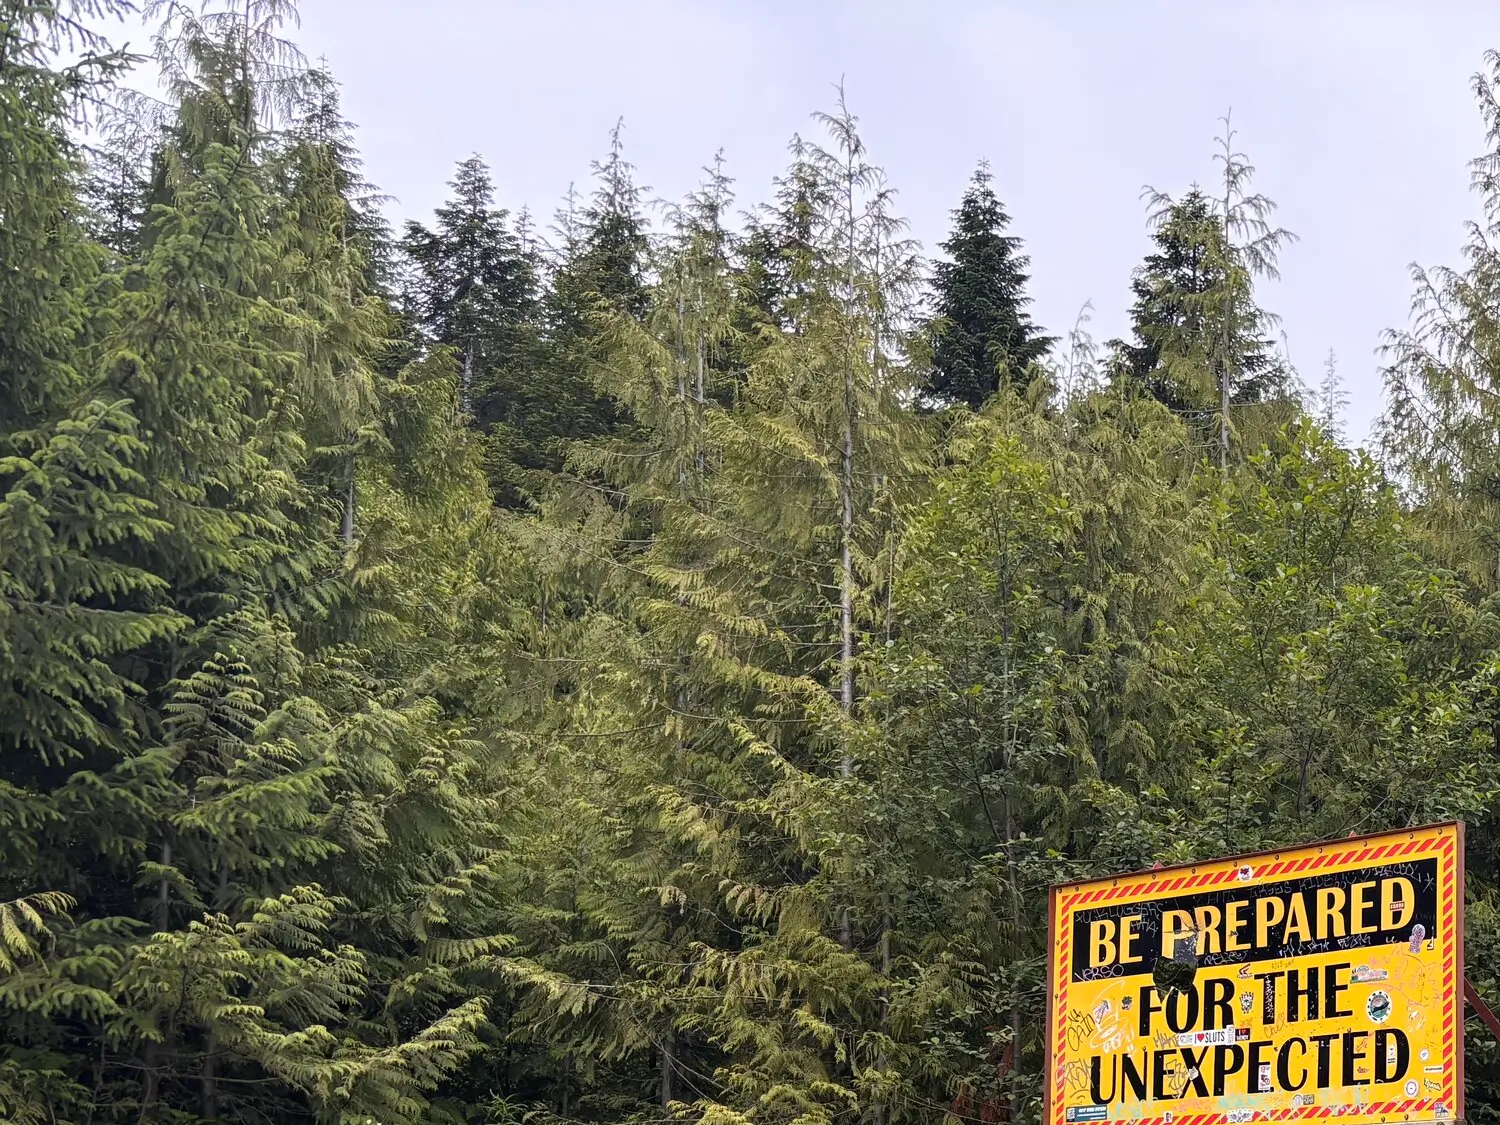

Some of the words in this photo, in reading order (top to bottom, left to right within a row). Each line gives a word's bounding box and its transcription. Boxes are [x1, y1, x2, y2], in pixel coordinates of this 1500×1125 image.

[1090, 915, 1142, 967] BE
[1162, 877, 1415, 959] PREPARED
[1139, 978, 1234, 1036] FOR
[1254, 962, 1353, 1025] THE
[1090, 1028, 1410, 1105] UNEXPECTED
[1204, 1031, 1226, 1044] SLUTS
